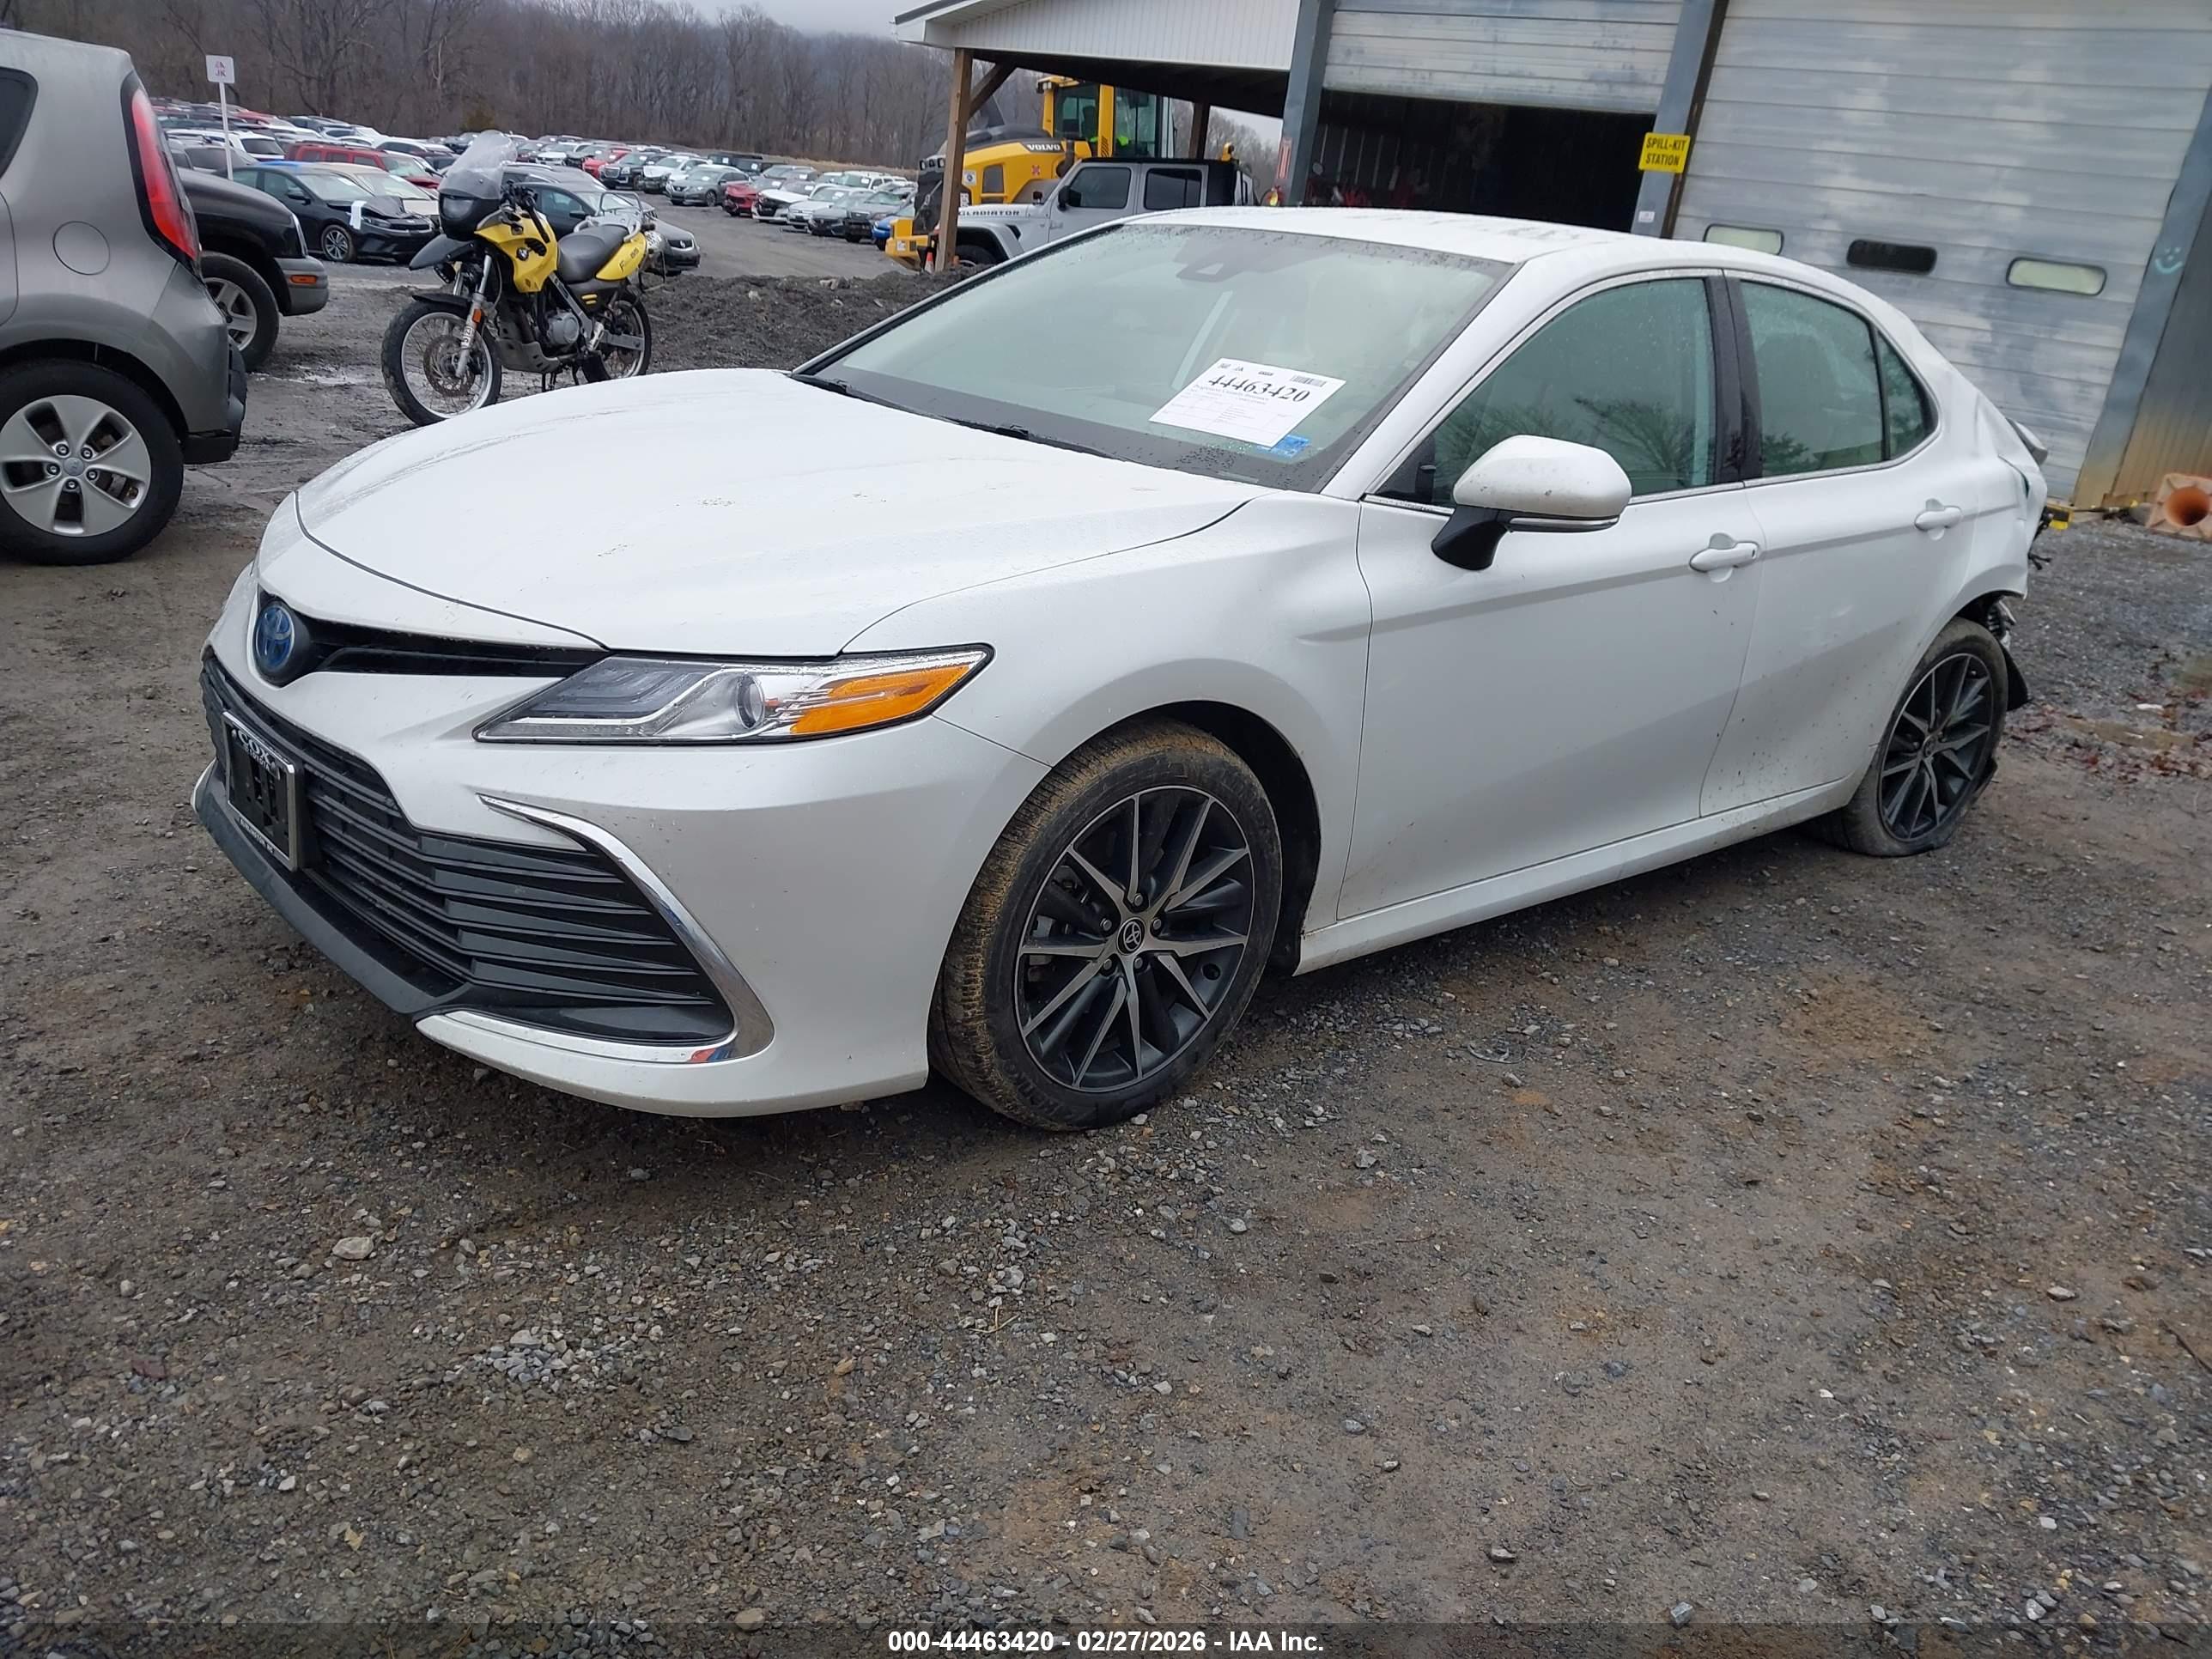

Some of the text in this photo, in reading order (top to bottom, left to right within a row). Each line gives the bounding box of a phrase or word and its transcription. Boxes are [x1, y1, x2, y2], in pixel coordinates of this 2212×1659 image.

[1646, 137, 1686, 152] SPILL-KIT
[1646, 154, 1680, 166] STATION
[1208, 374, 1310, 403] 44463420
[238, 730, 271, 765] COX
